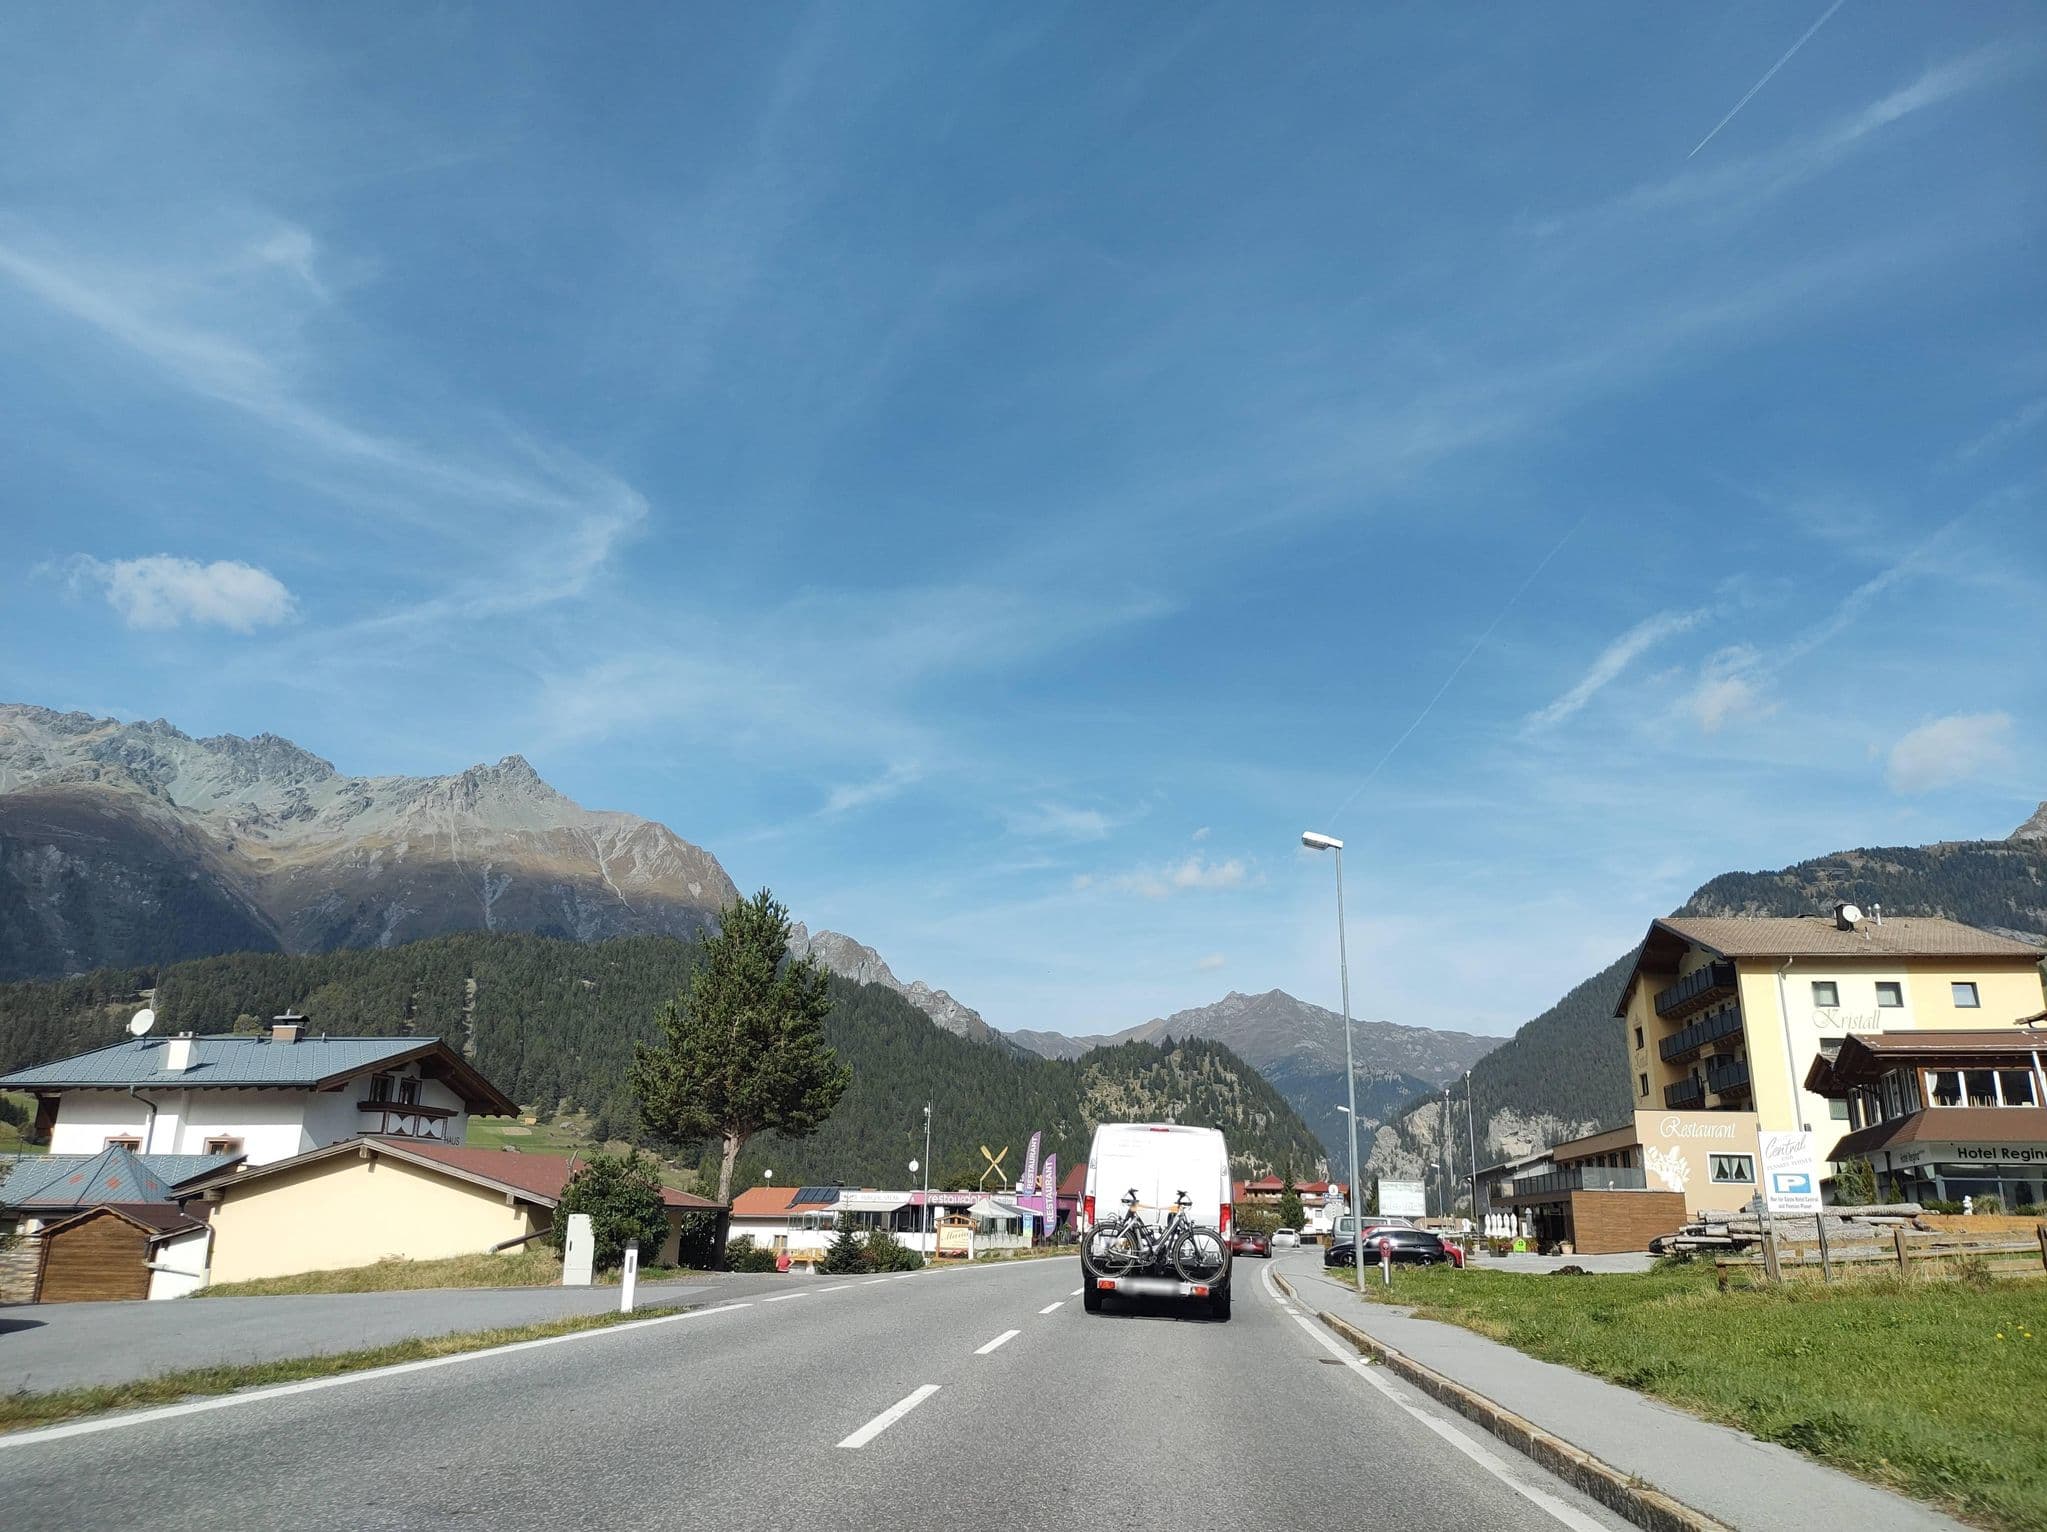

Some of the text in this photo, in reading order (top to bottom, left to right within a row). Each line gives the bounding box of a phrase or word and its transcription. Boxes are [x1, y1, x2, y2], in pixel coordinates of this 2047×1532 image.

[1812, 1008, 1881, 1030] Kristall
[1660, 1115, 1736, 1138] Restaurant
[1765, 1134, 1806, 1158] Central
[1957, 1147, 1997, 1159] Hotel
[1026, 1136, 1039, 1190] RESTAURANT
[1044, 1160, 1055, 1223] RESTAURANT
